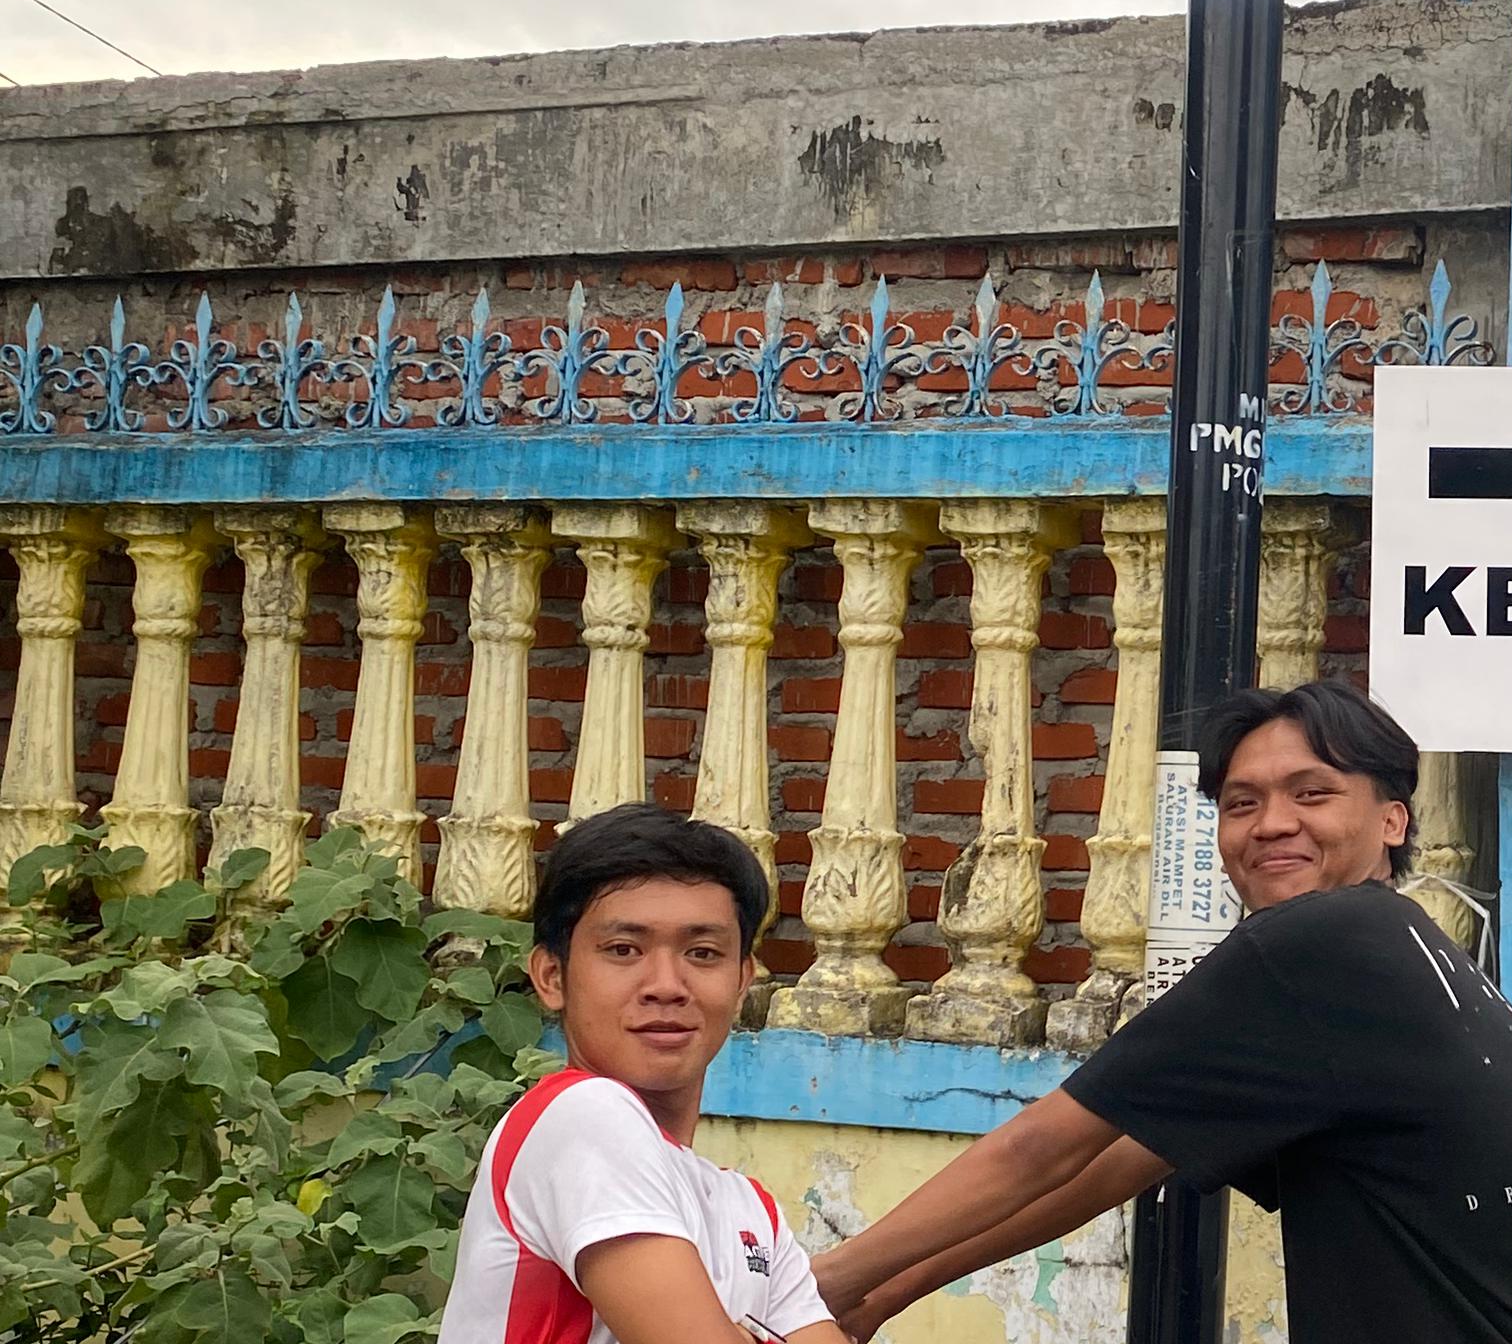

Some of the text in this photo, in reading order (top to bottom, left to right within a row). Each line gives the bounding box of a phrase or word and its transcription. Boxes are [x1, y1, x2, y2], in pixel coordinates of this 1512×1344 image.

[1190, 423, 1264, 459] PMG
[1160, 772, 1175, 921] SALURAN AIR DLL
[1172, 785, 1187, 910] ATASI MAMPET
[1195, 827, 1215, 872] 7188
[1192, 878, 1212, 923] 3727
[1172, 957, 1187, 985] AT
